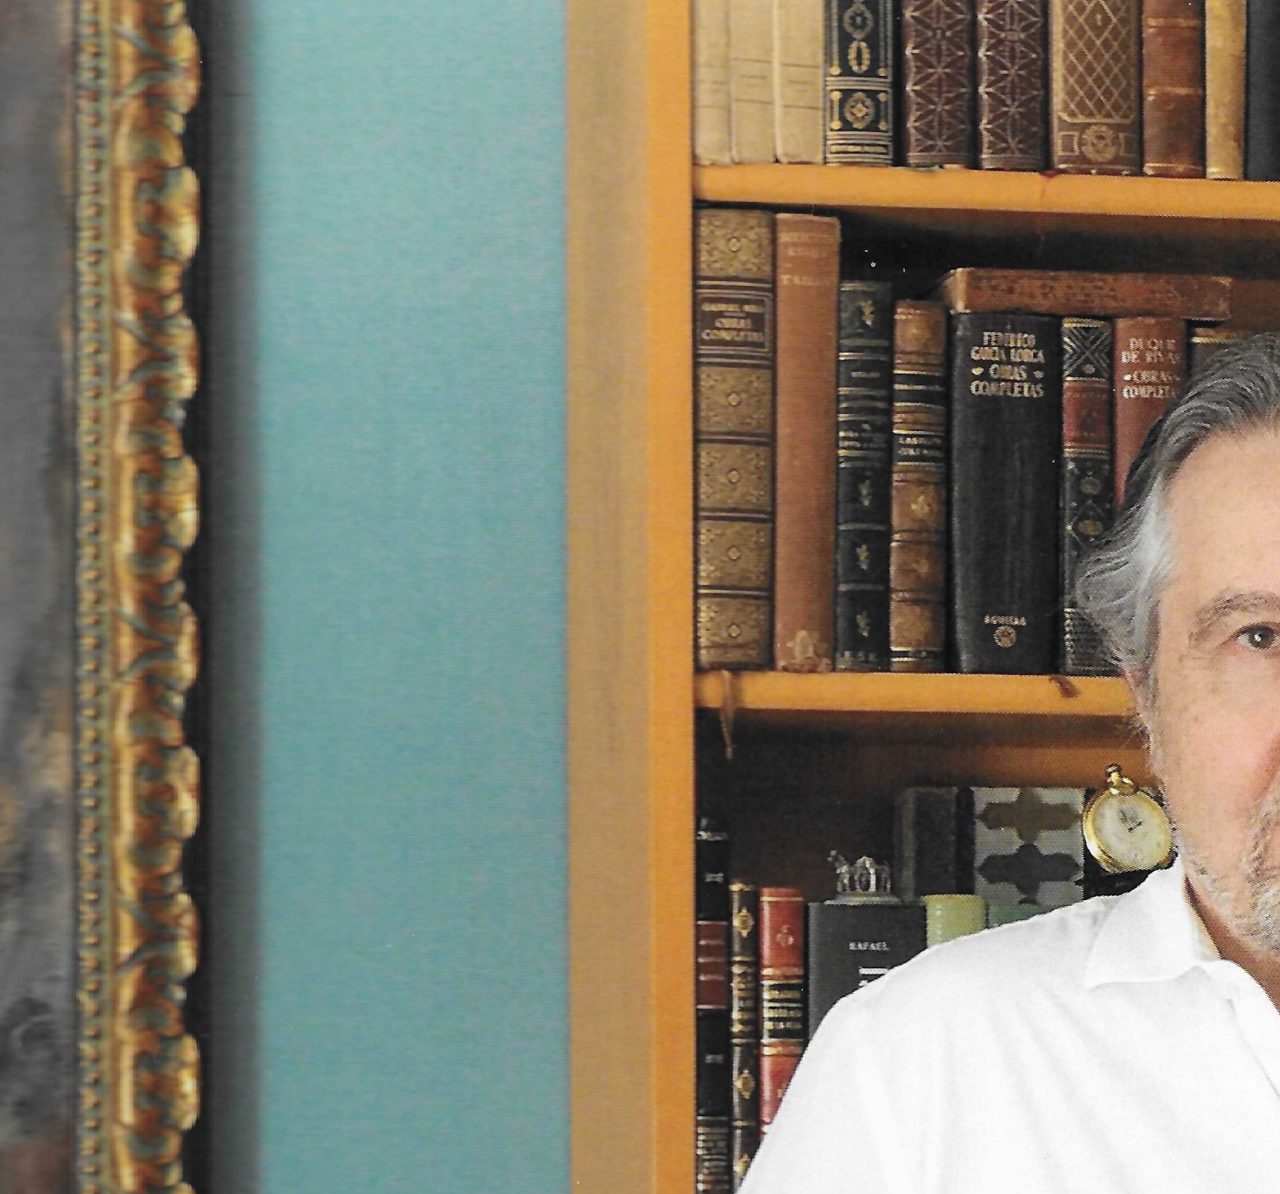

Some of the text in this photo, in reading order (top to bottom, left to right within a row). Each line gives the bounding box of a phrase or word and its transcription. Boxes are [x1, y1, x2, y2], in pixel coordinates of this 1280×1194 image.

[983, 331, 1036, 348] FEDERICO
[1009, 348, 1045, 363] LORCA
[1121, 350, 1141, 364] DE
[989, 363, 1027, 380] OBRAS
[970, 380, 1045, 398] COMPLETAS
[848, 941, 890, 951] RAFAEL
